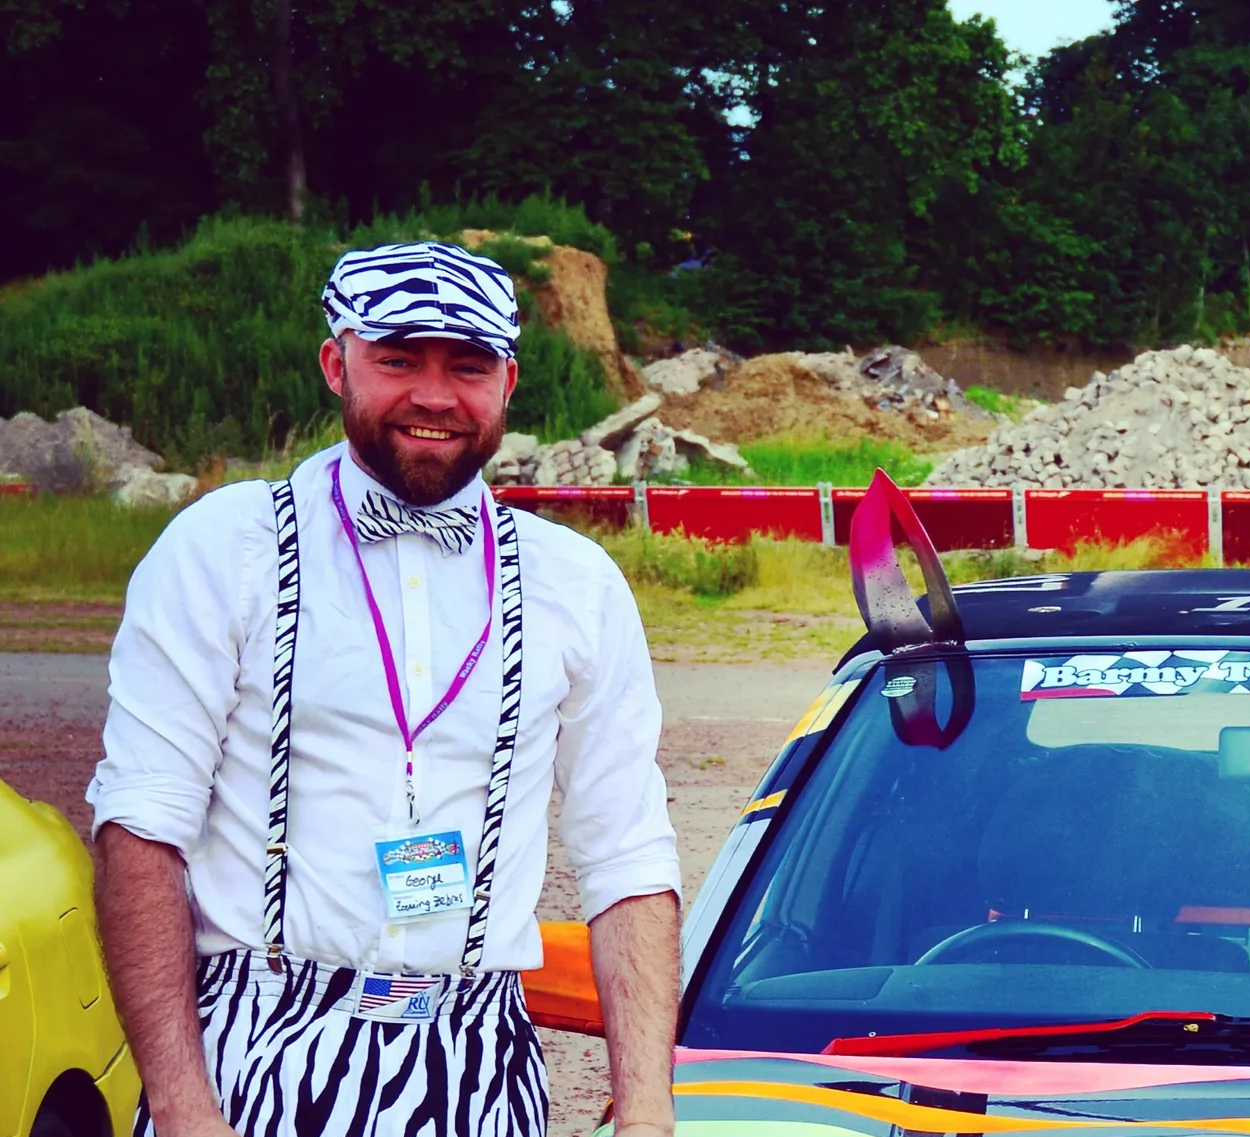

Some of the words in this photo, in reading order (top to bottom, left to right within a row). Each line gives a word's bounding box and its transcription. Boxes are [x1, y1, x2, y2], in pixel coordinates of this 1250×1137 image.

[459, 657, 477, 678] Wacky
[471, 640, 486, 657] Rally
[1041, 663, 1204, 692] Barmy
